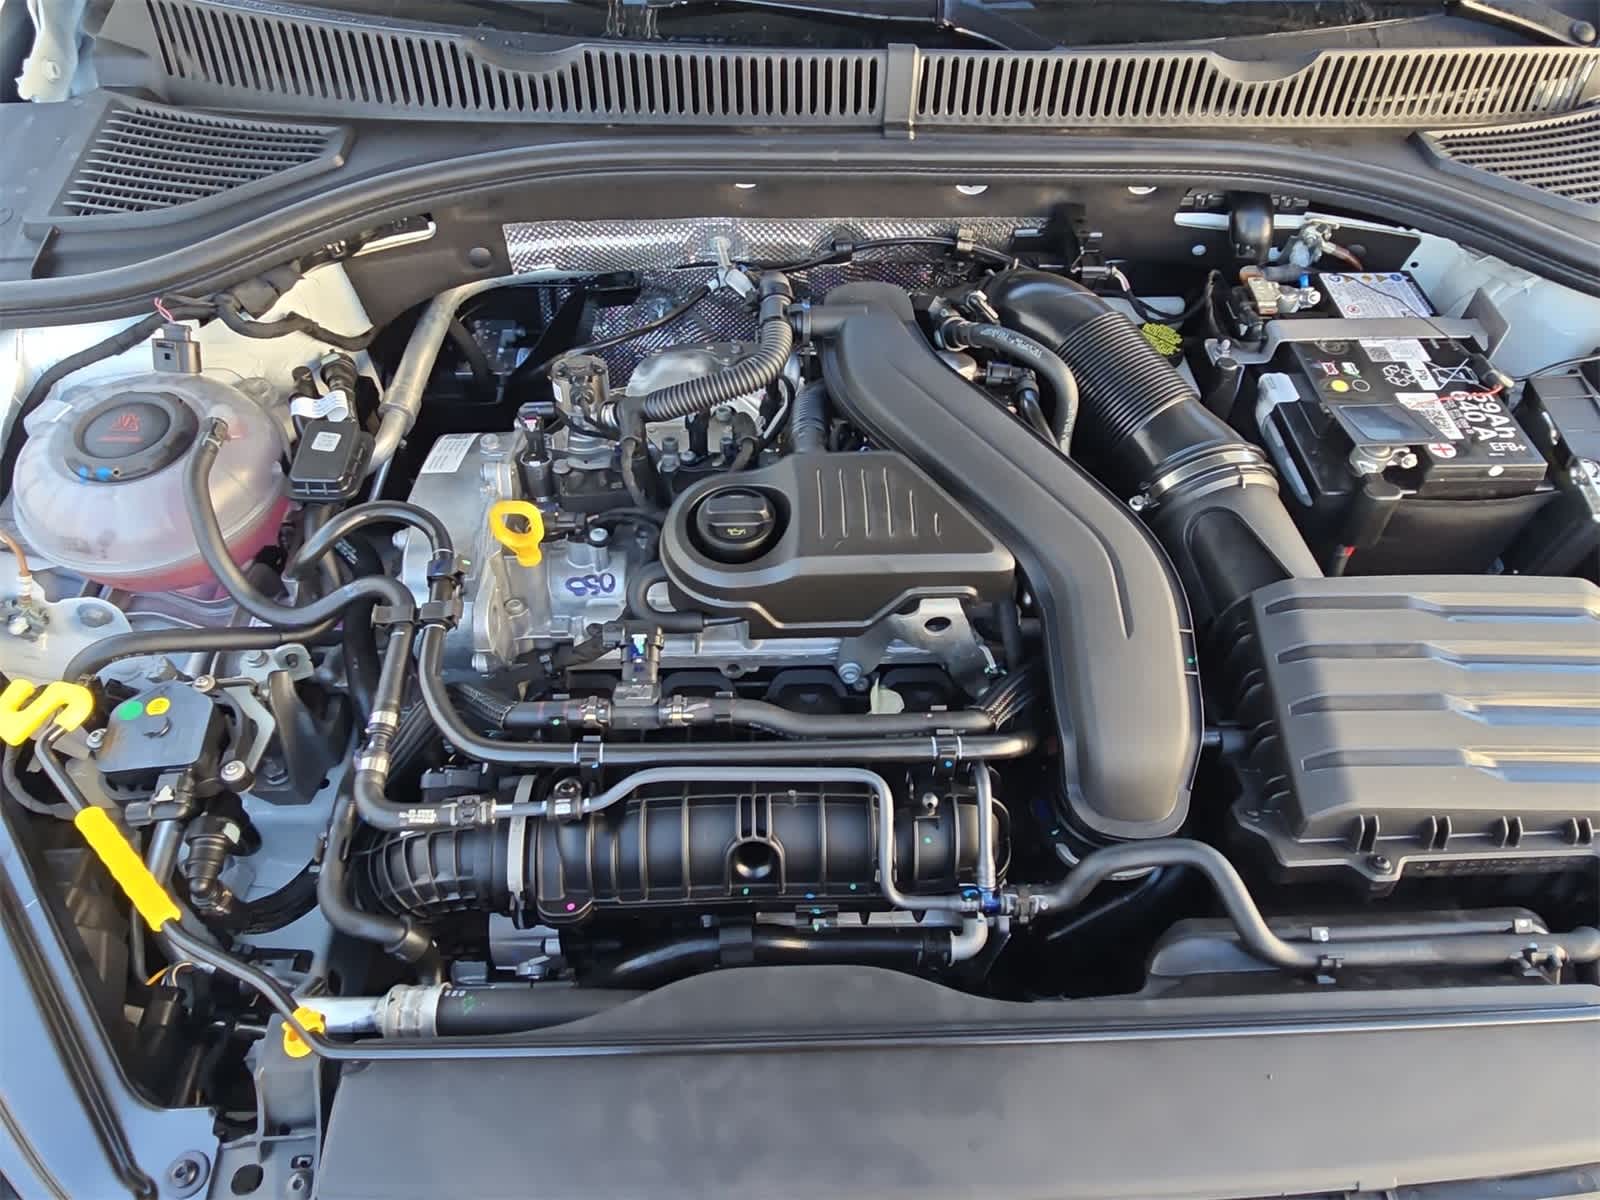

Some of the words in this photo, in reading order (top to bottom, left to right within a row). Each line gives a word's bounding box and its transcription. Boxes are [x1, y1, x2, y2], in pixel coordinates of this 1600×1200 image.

[1450, 391, 1488, 422] 640
[1473, 426, 1498, 441] A
[1470, 392, 1517, 439] 59Ah
